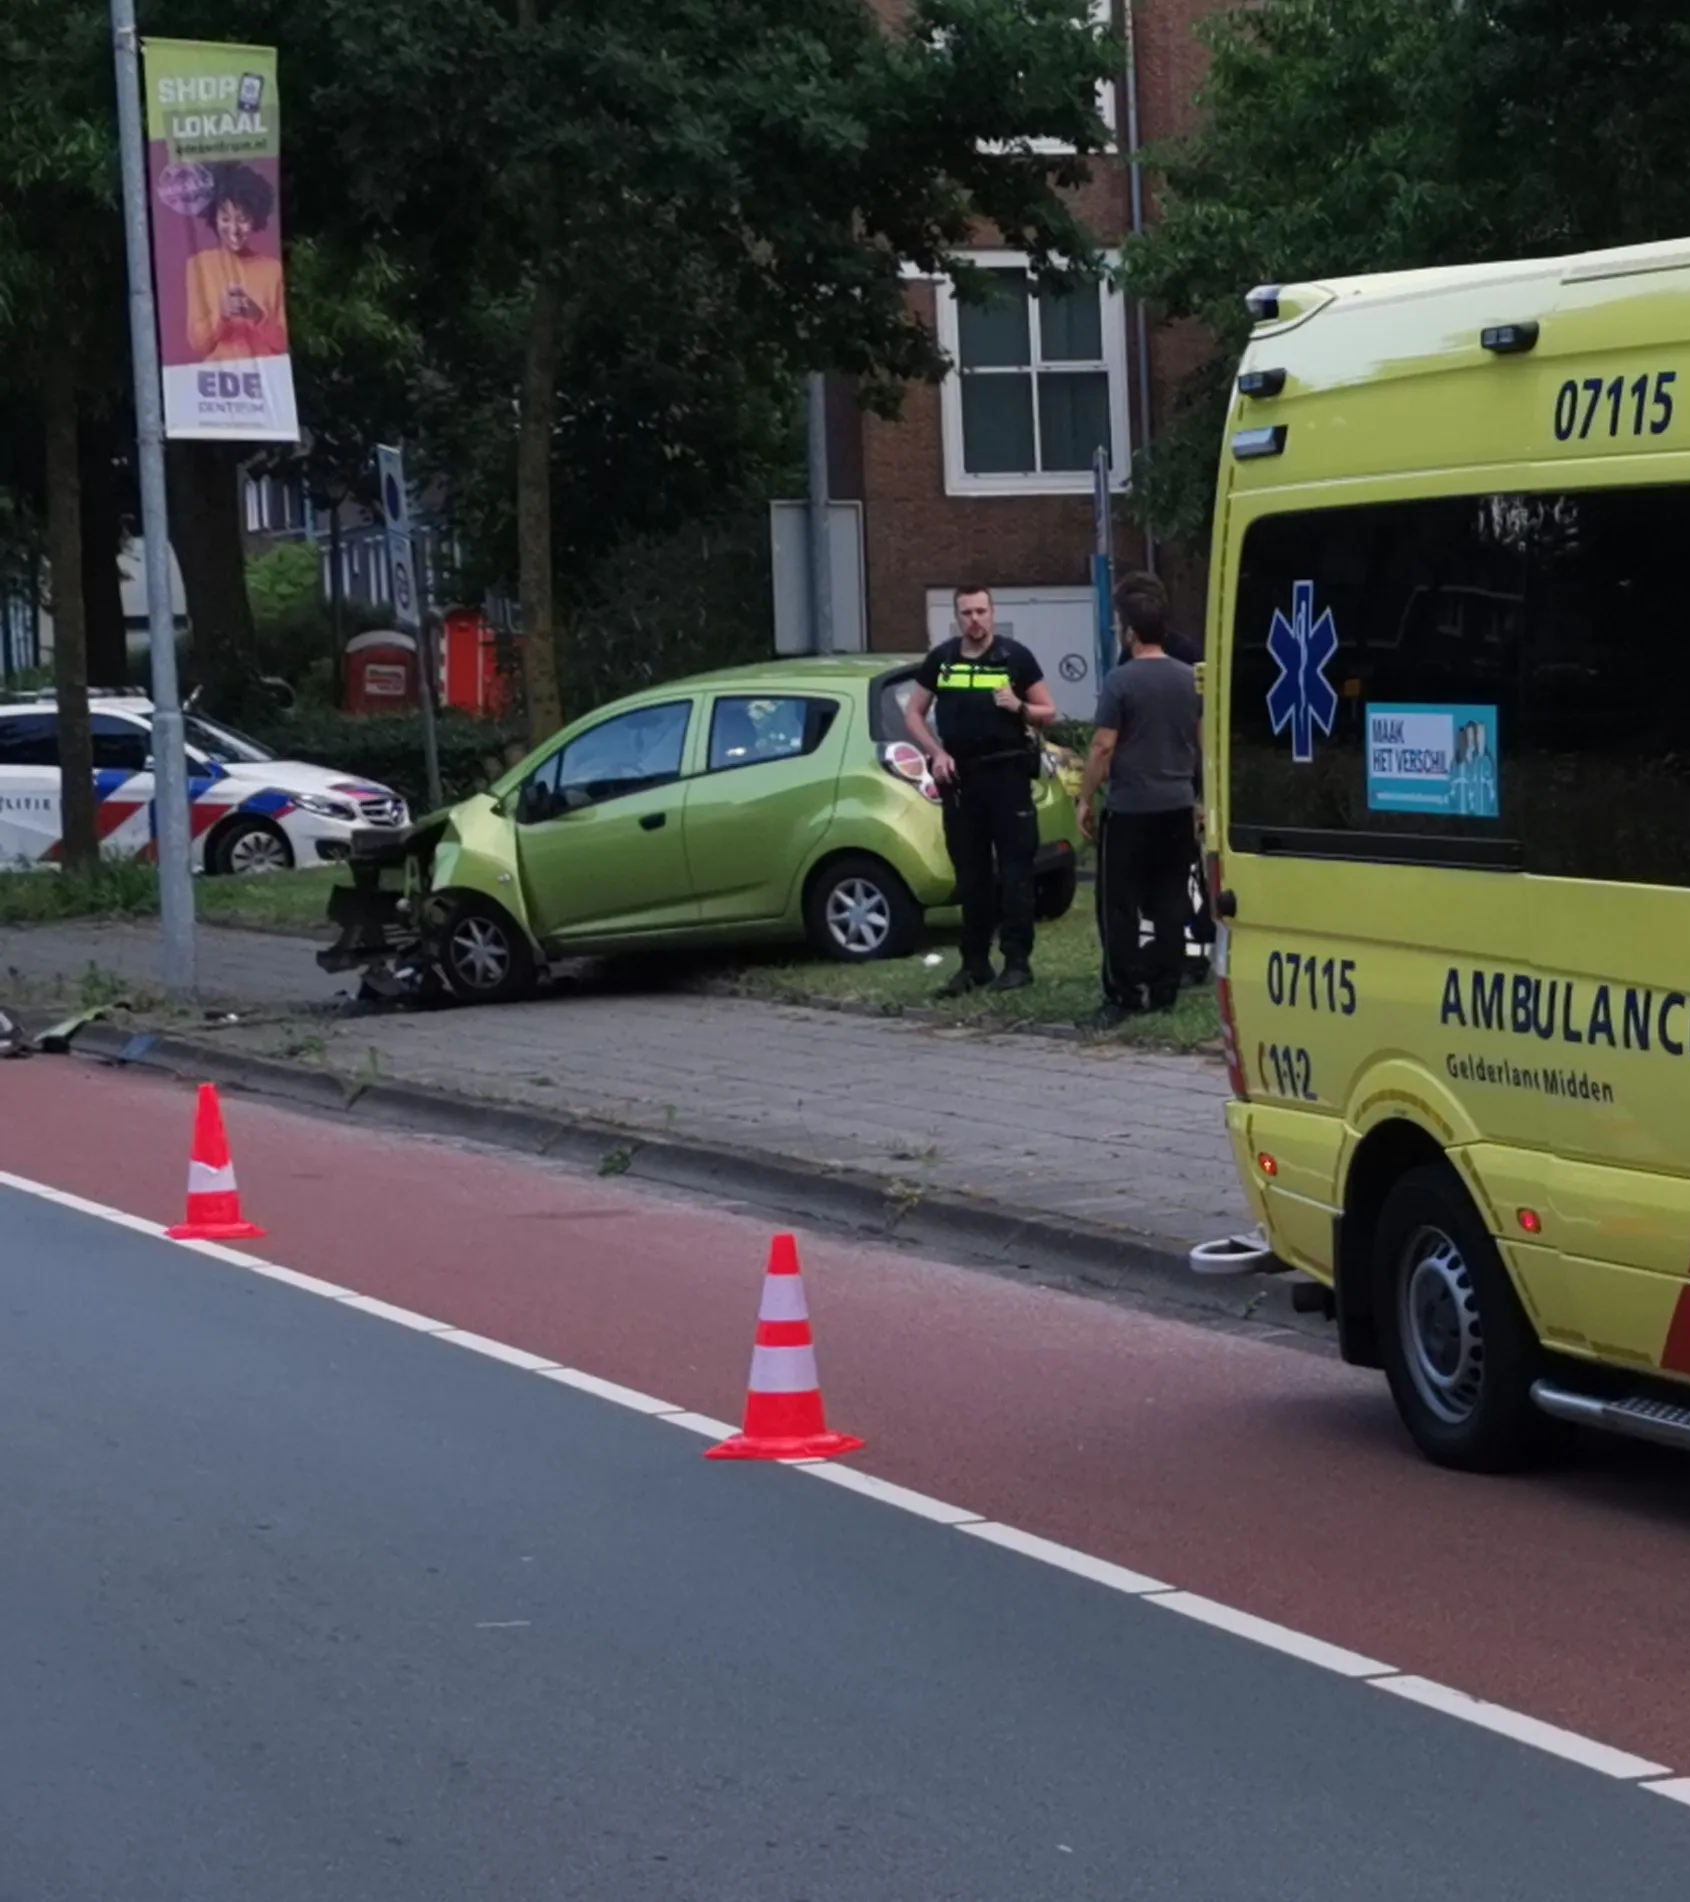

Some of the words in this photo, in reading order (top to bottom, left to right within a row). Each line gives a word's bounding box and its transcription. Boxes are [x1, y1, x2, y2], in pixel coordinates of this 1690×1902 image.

[157, 75, 238, 104] SHOP
[172, 111, 269, 138] LOKAAL
[197, 370, 263, 400] EDE
[1554, 371, 1677, 441] 07115
[1372, 747, 1393, 773] HET
[1267, 950, 1357, 1017] 07115
[1542, 1067, 1615, 1104] Midden
